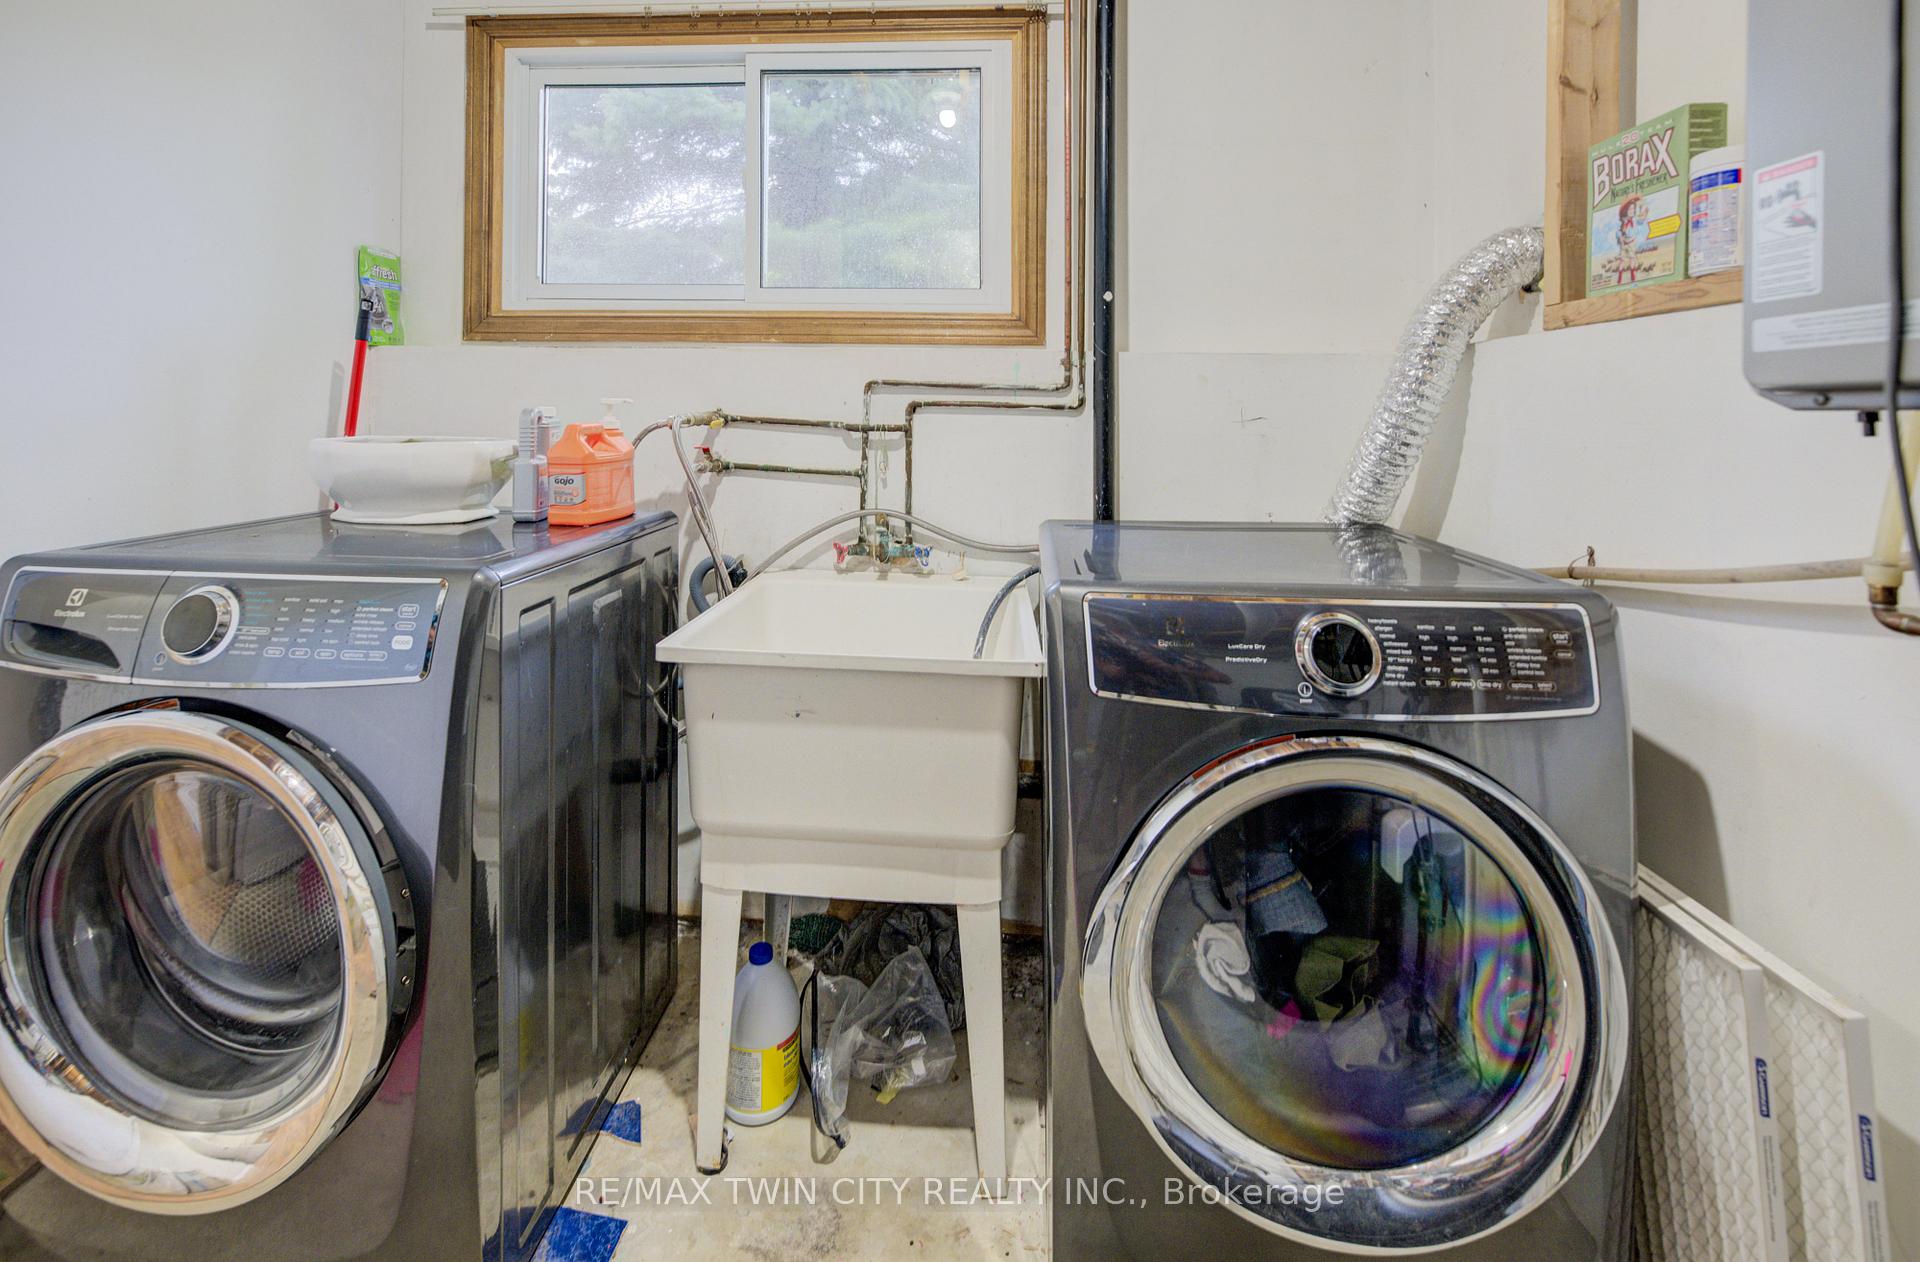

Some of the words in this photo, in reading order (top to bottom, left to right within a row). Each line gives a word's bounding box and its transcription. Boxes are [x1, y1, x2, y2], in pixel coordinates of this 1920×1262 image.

[1592, 127, 1680, 209] BORAX
[1552, 633, 1569, 641] start
[1254, 643, 1266, 651] Dry
[1225, 656, 1268, 664] PredictiveDry
